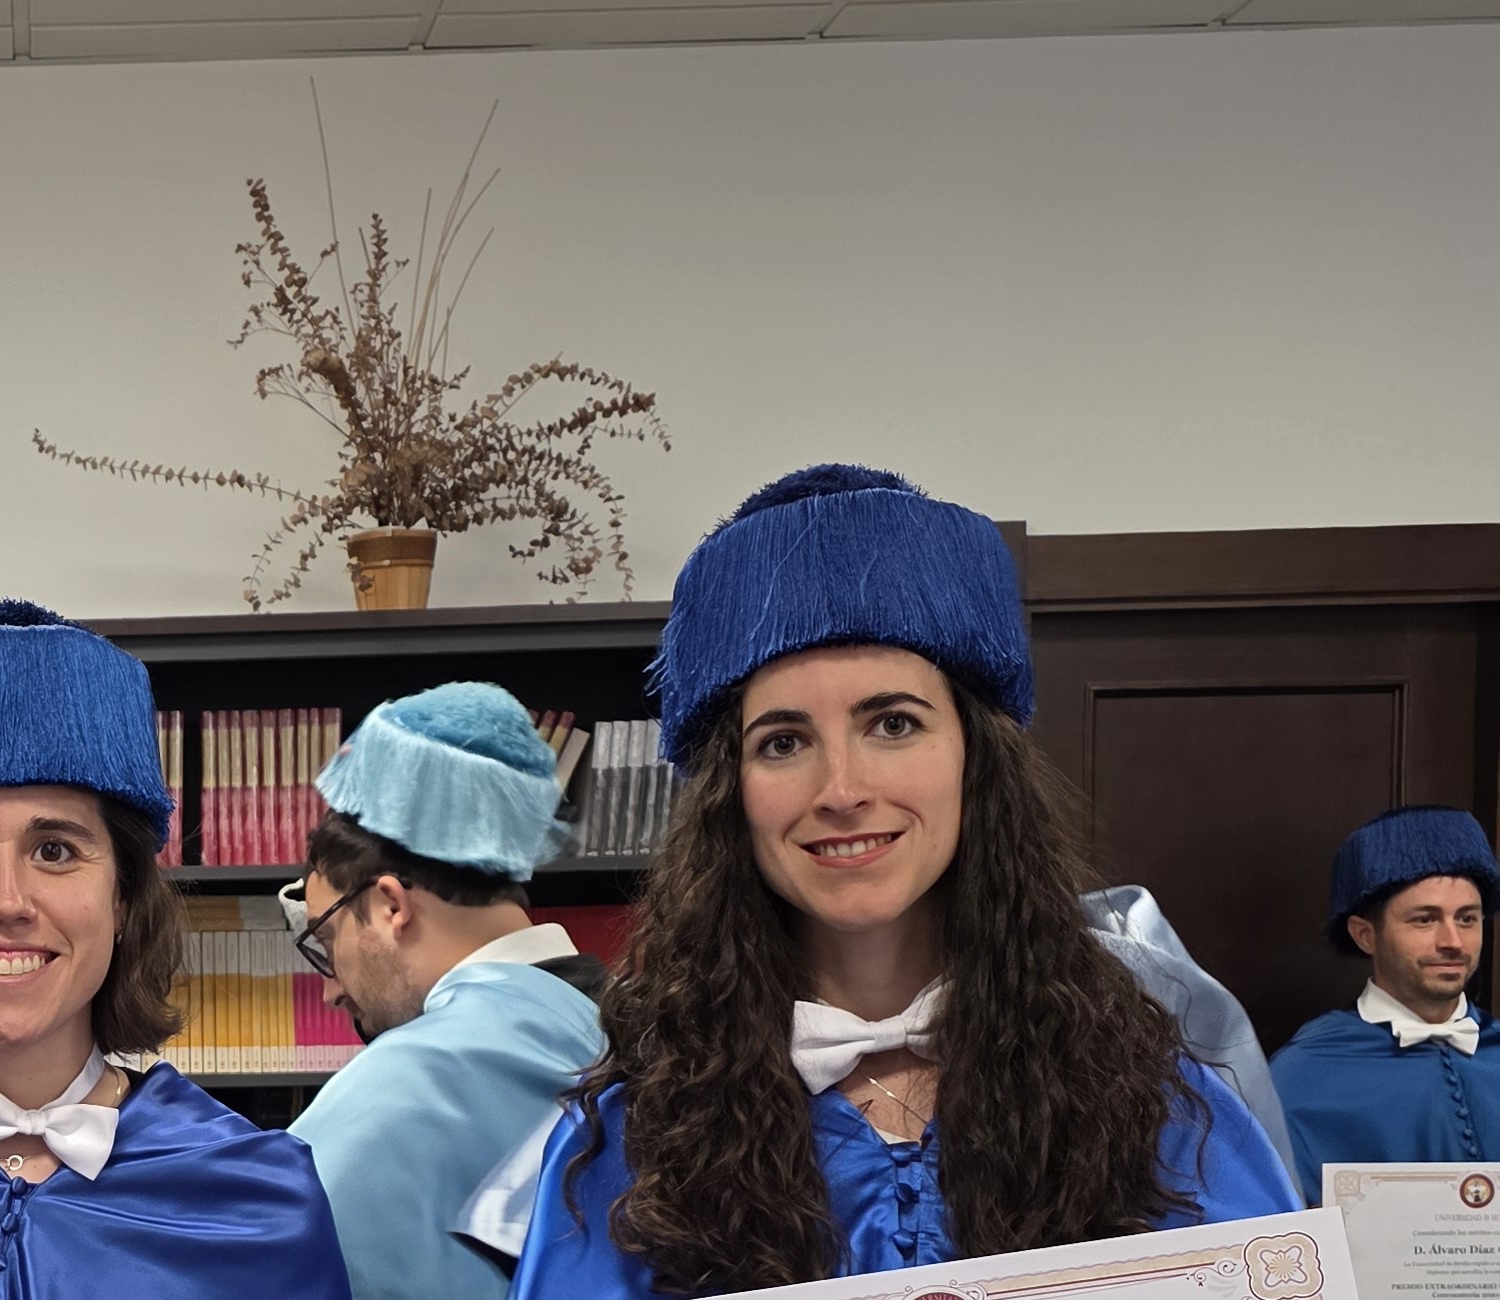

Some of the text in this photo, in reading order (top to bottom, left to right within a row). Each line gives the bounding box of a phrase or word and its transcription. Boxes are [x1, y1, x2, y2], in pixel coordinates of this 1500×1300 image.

[1414, 1242, 1495, 1255] D. Álvaro Díaz
